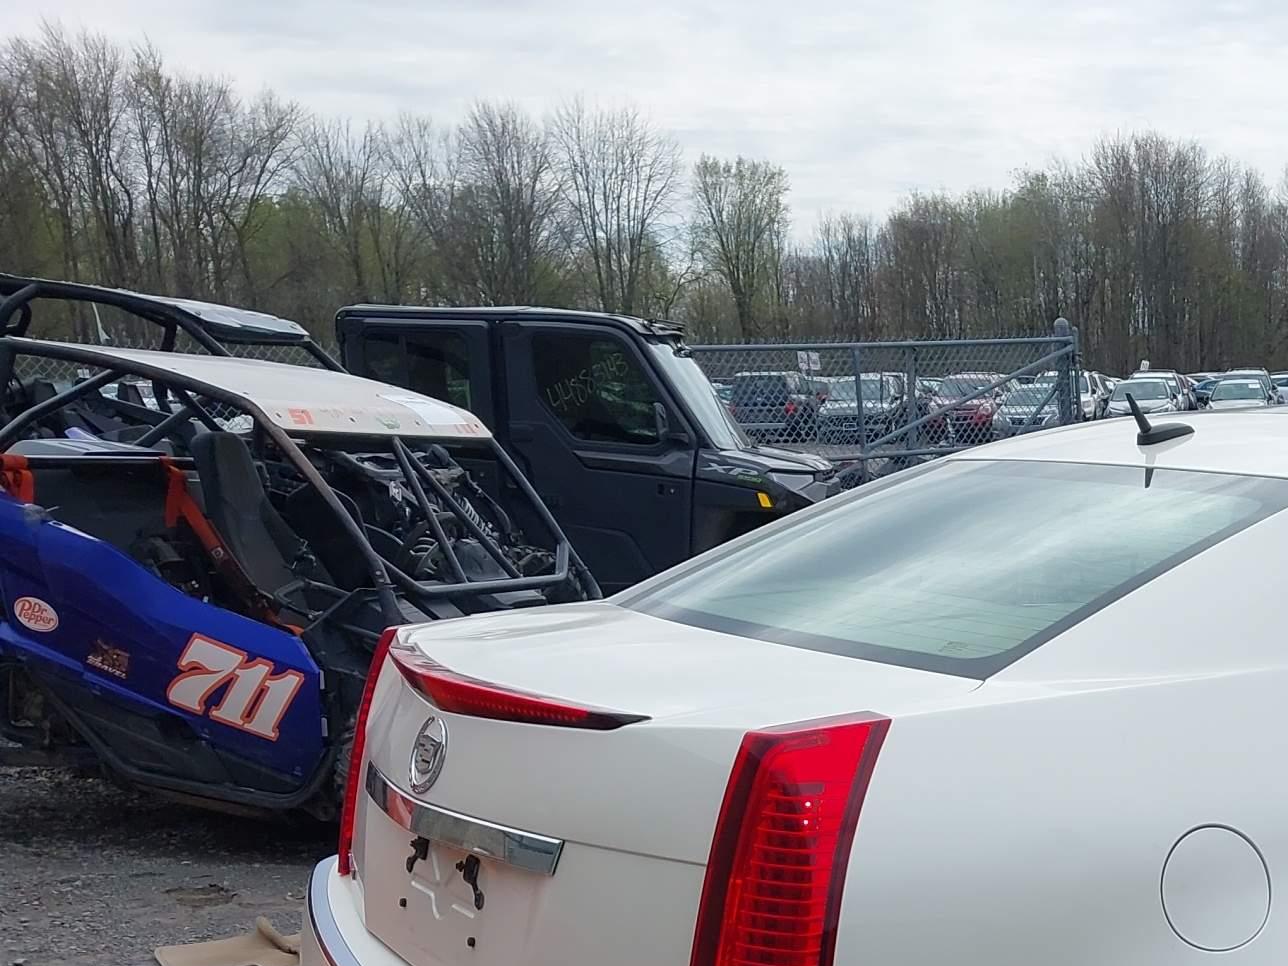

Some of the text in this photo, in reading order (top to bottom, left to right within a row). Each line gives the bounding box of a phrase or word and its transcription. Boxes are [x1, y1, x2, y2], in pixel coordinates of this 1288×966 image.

[700, 462, 760, 476] XP
[18, 599, 55, 625] Pepper
[32, 602, 48, 614] Dr
[166, 632, 305, 742] 711
